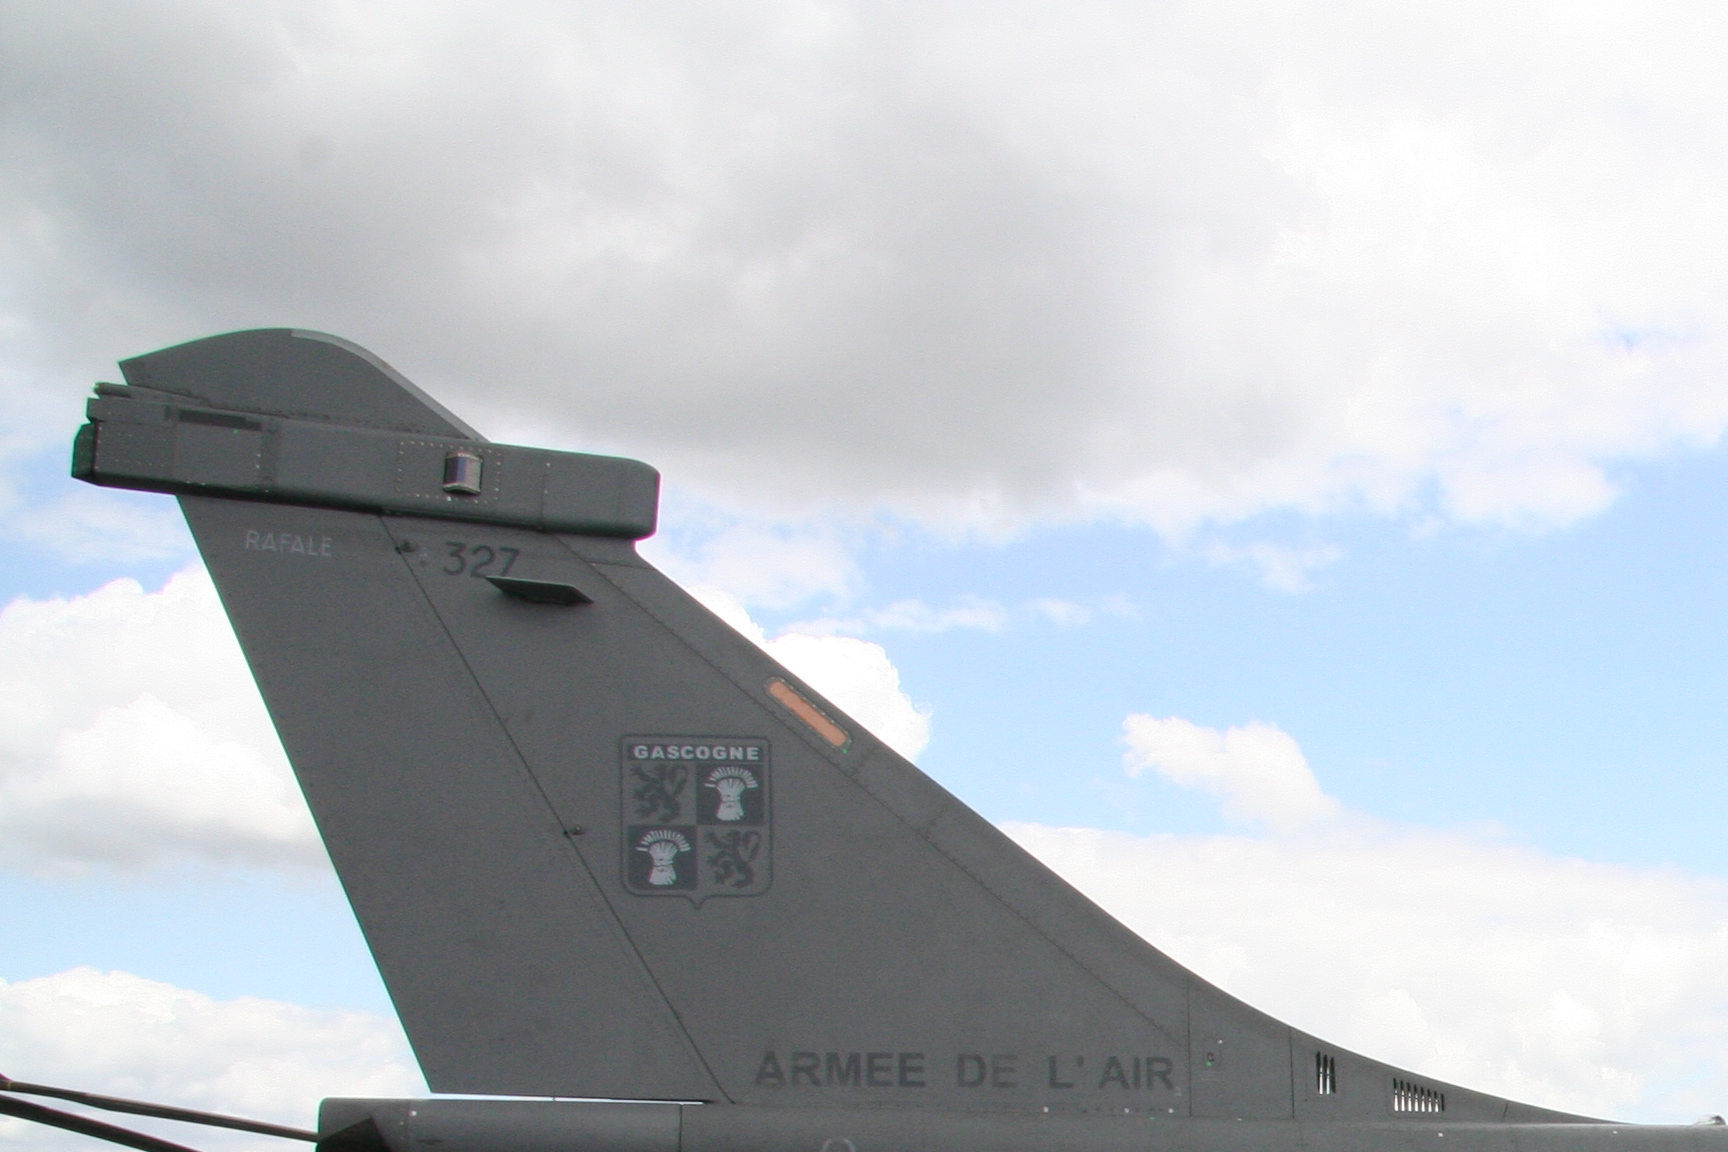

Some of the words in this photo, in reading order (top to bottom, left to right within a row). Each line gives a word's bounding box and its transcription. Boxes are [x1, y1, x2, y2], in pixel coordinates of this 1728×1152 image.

[245, 530, 332, 557] RAFALE
[442, 540, 520, 578] 327
[633, 744, 760, 760] GASCOGNE
[754, 1051, 927, 1088] ARMEE
[956, 1052, 1019, 1089] DE
